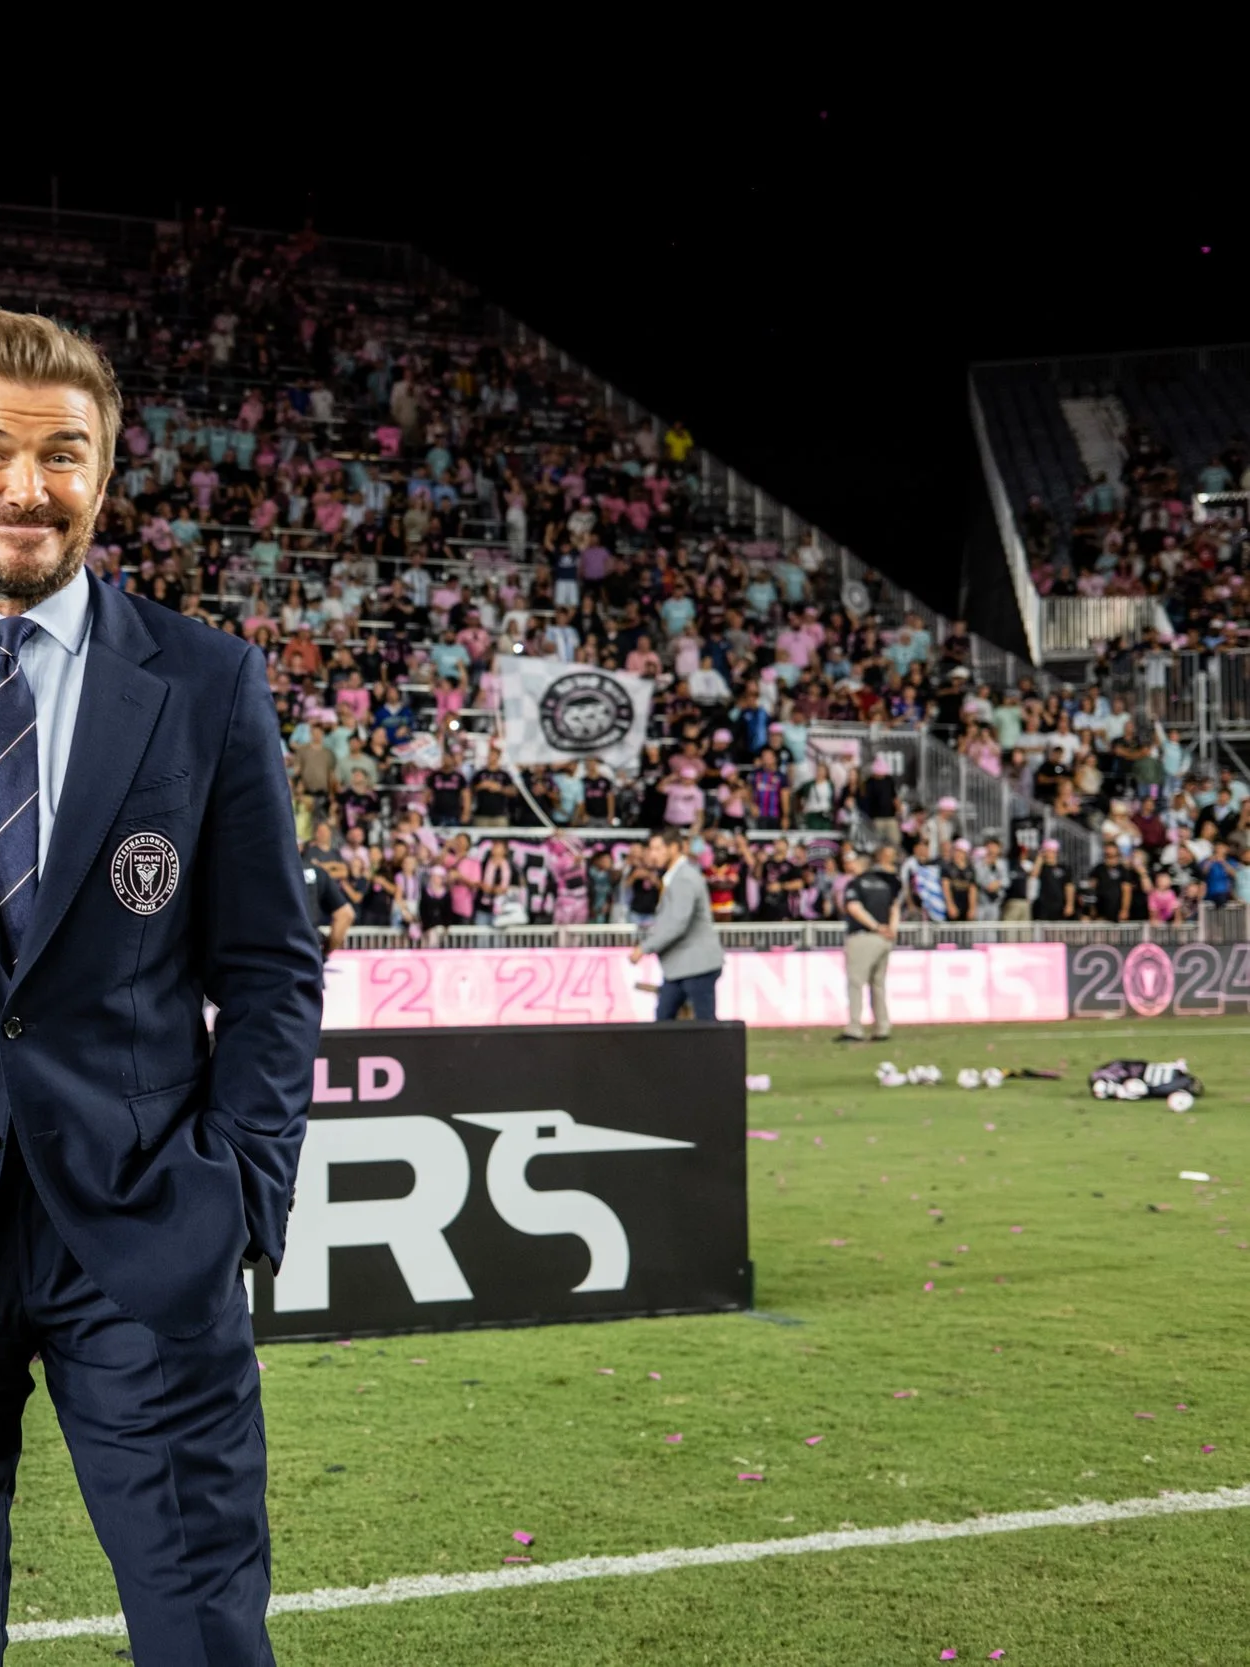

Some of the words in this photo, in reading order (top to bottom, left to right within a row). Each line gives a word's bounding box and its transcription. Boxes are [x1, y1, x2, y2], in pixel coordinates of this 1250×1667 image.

[114, 836, 169, 869] INTERNACIONAL
[134, 854, 161, 863] MIAMI
[167, 850, 176, 862] DE
[114, 872, 125, 894] CLUB
[135, 902, 157, 912] MMXX
